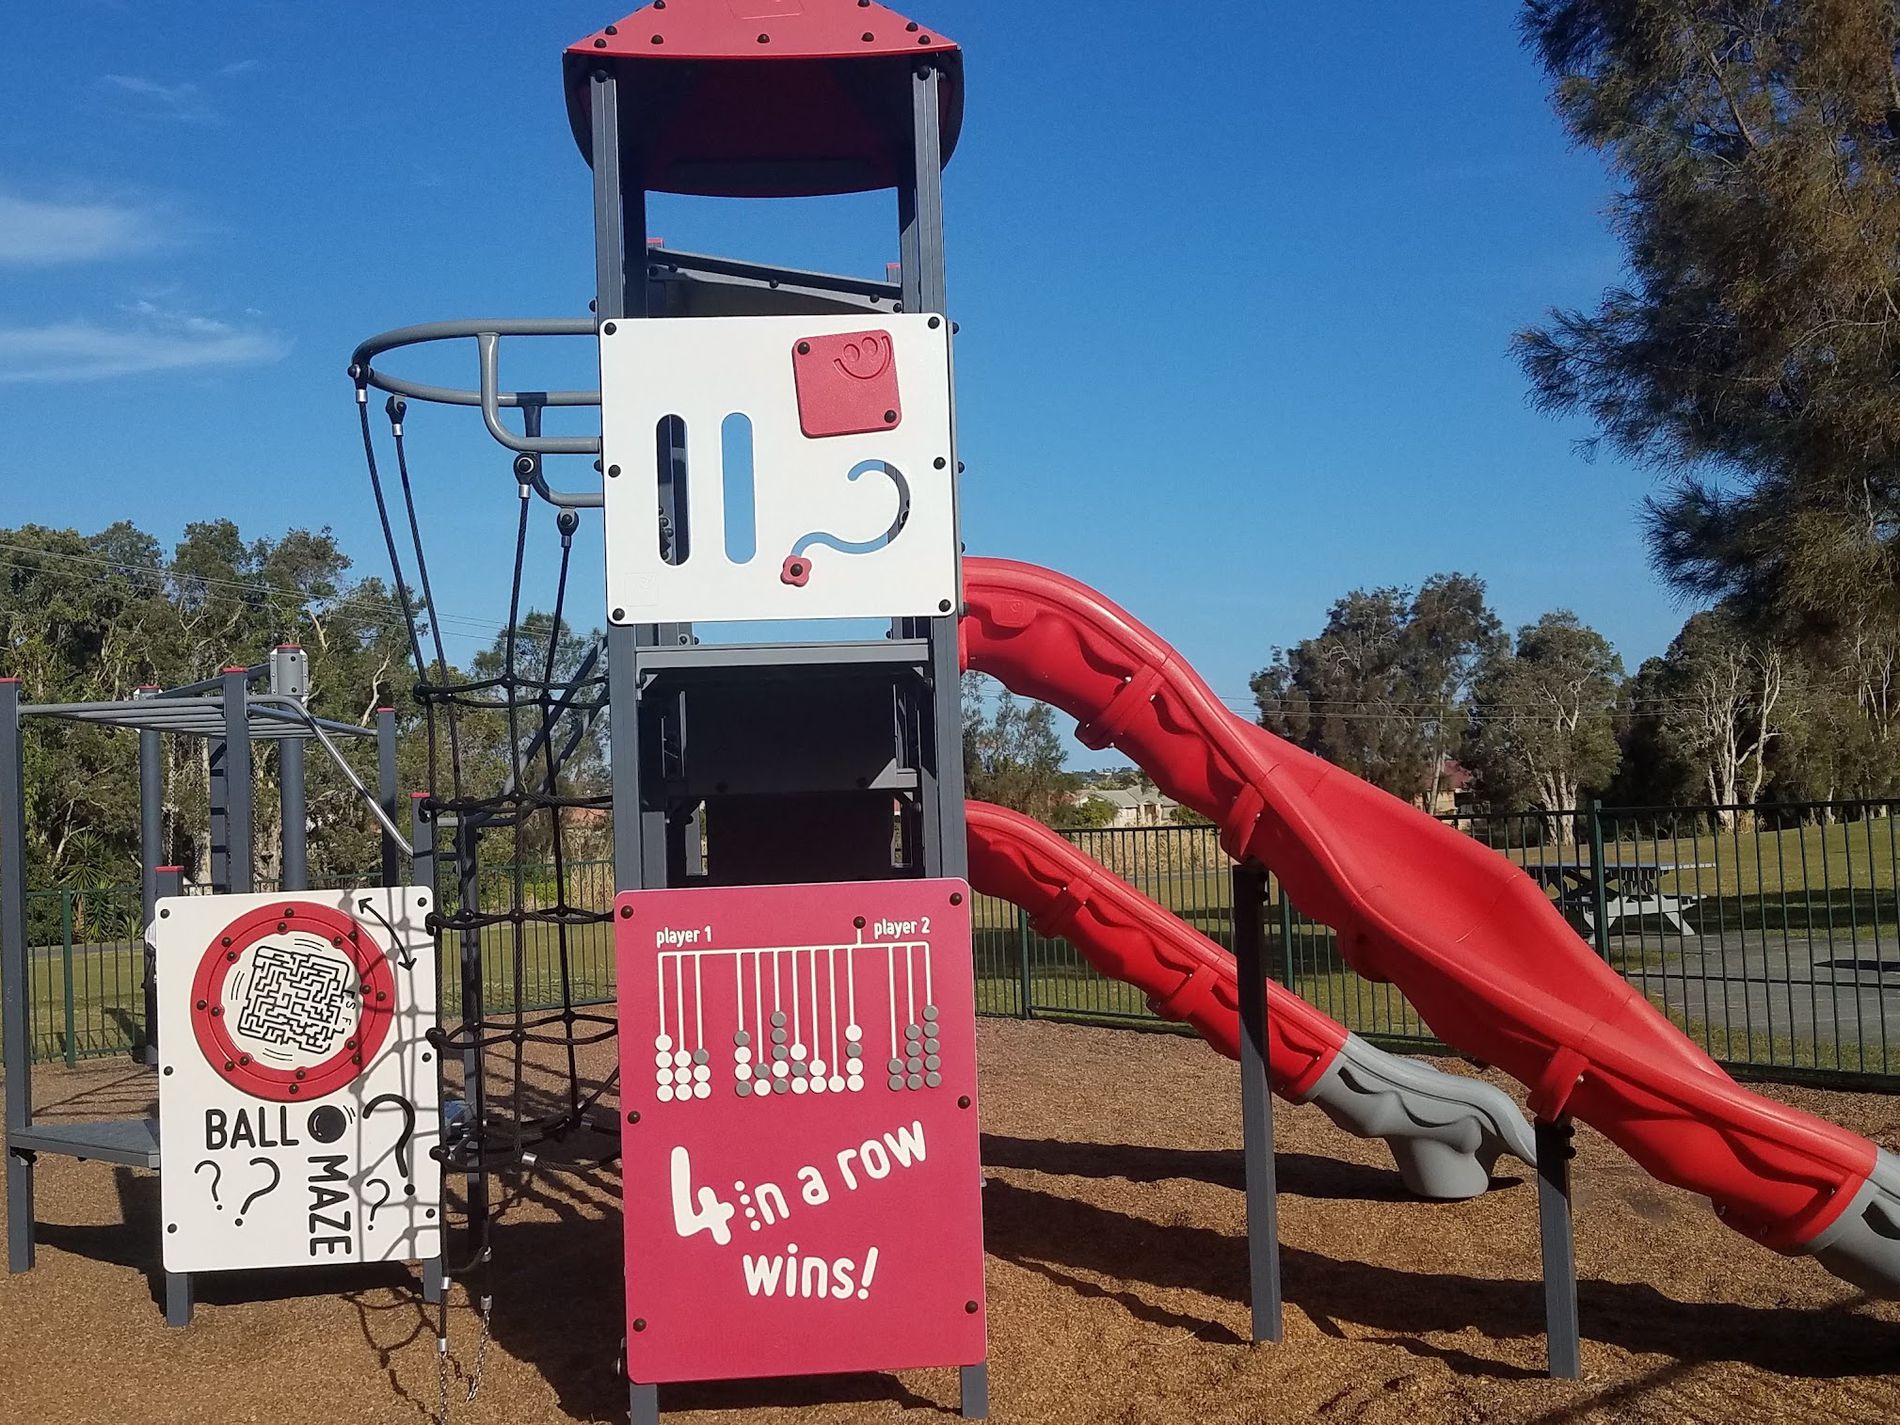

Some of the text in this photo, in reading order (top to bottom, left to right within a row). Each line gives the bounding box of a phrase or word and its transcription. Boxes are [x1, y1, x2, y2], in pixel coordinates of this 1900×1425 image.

[656, 925, 712, 948] player 1
[873, 916, 931, 939] player 2
[206, 1106, 299, 1150] BALL
[307, 1155, 352, 1257] MAZE
[670, 1146, 735, 1246] 4
[797, 1165, 830, 1205] a
[742, 1242, 879, 1300] wins!
